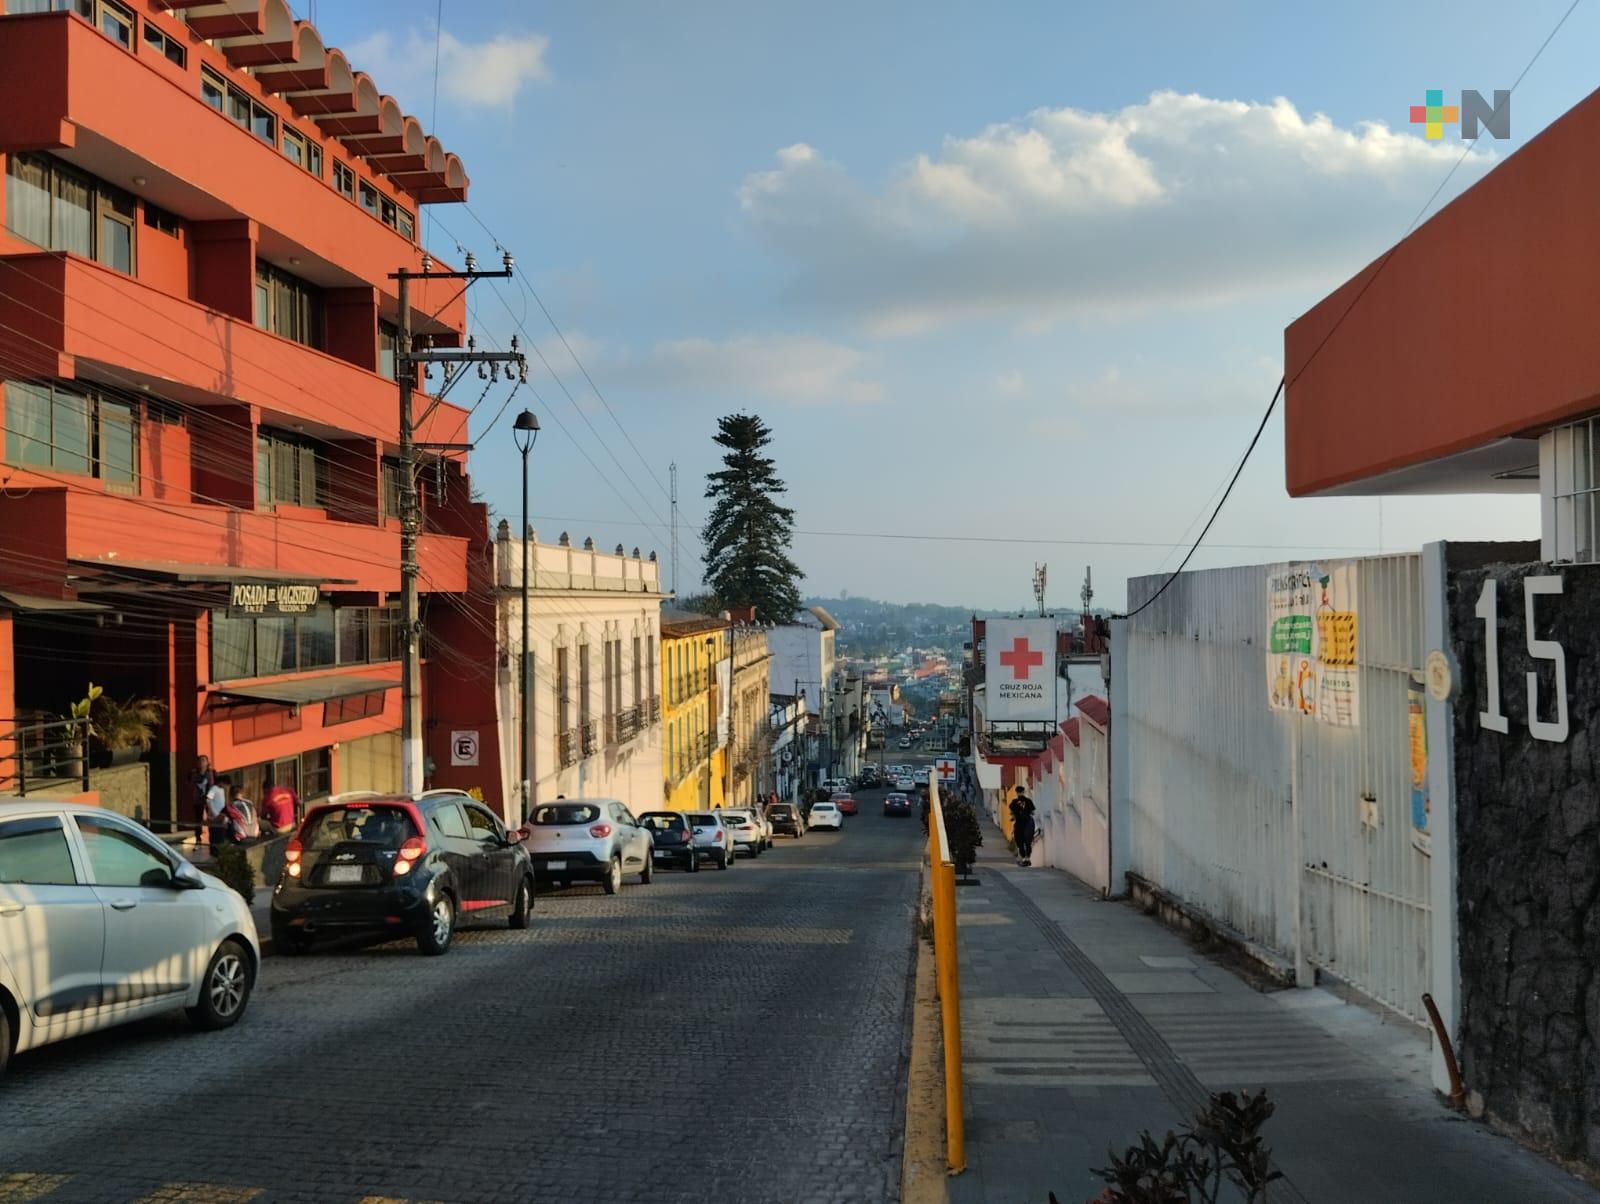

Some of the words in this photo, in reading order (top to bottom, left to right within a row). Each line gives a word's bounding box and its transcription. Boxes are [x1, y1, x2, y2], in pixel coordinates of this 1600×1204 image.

[233, 584, 268, 606] POSADA
[277, 585, 318, 605] MAGISTERIO
[1475, 575, 1569, 743] 15
[1000, 683, 1021, 691] CRUZ
[1022, 683, 1043, 691] ROJA
